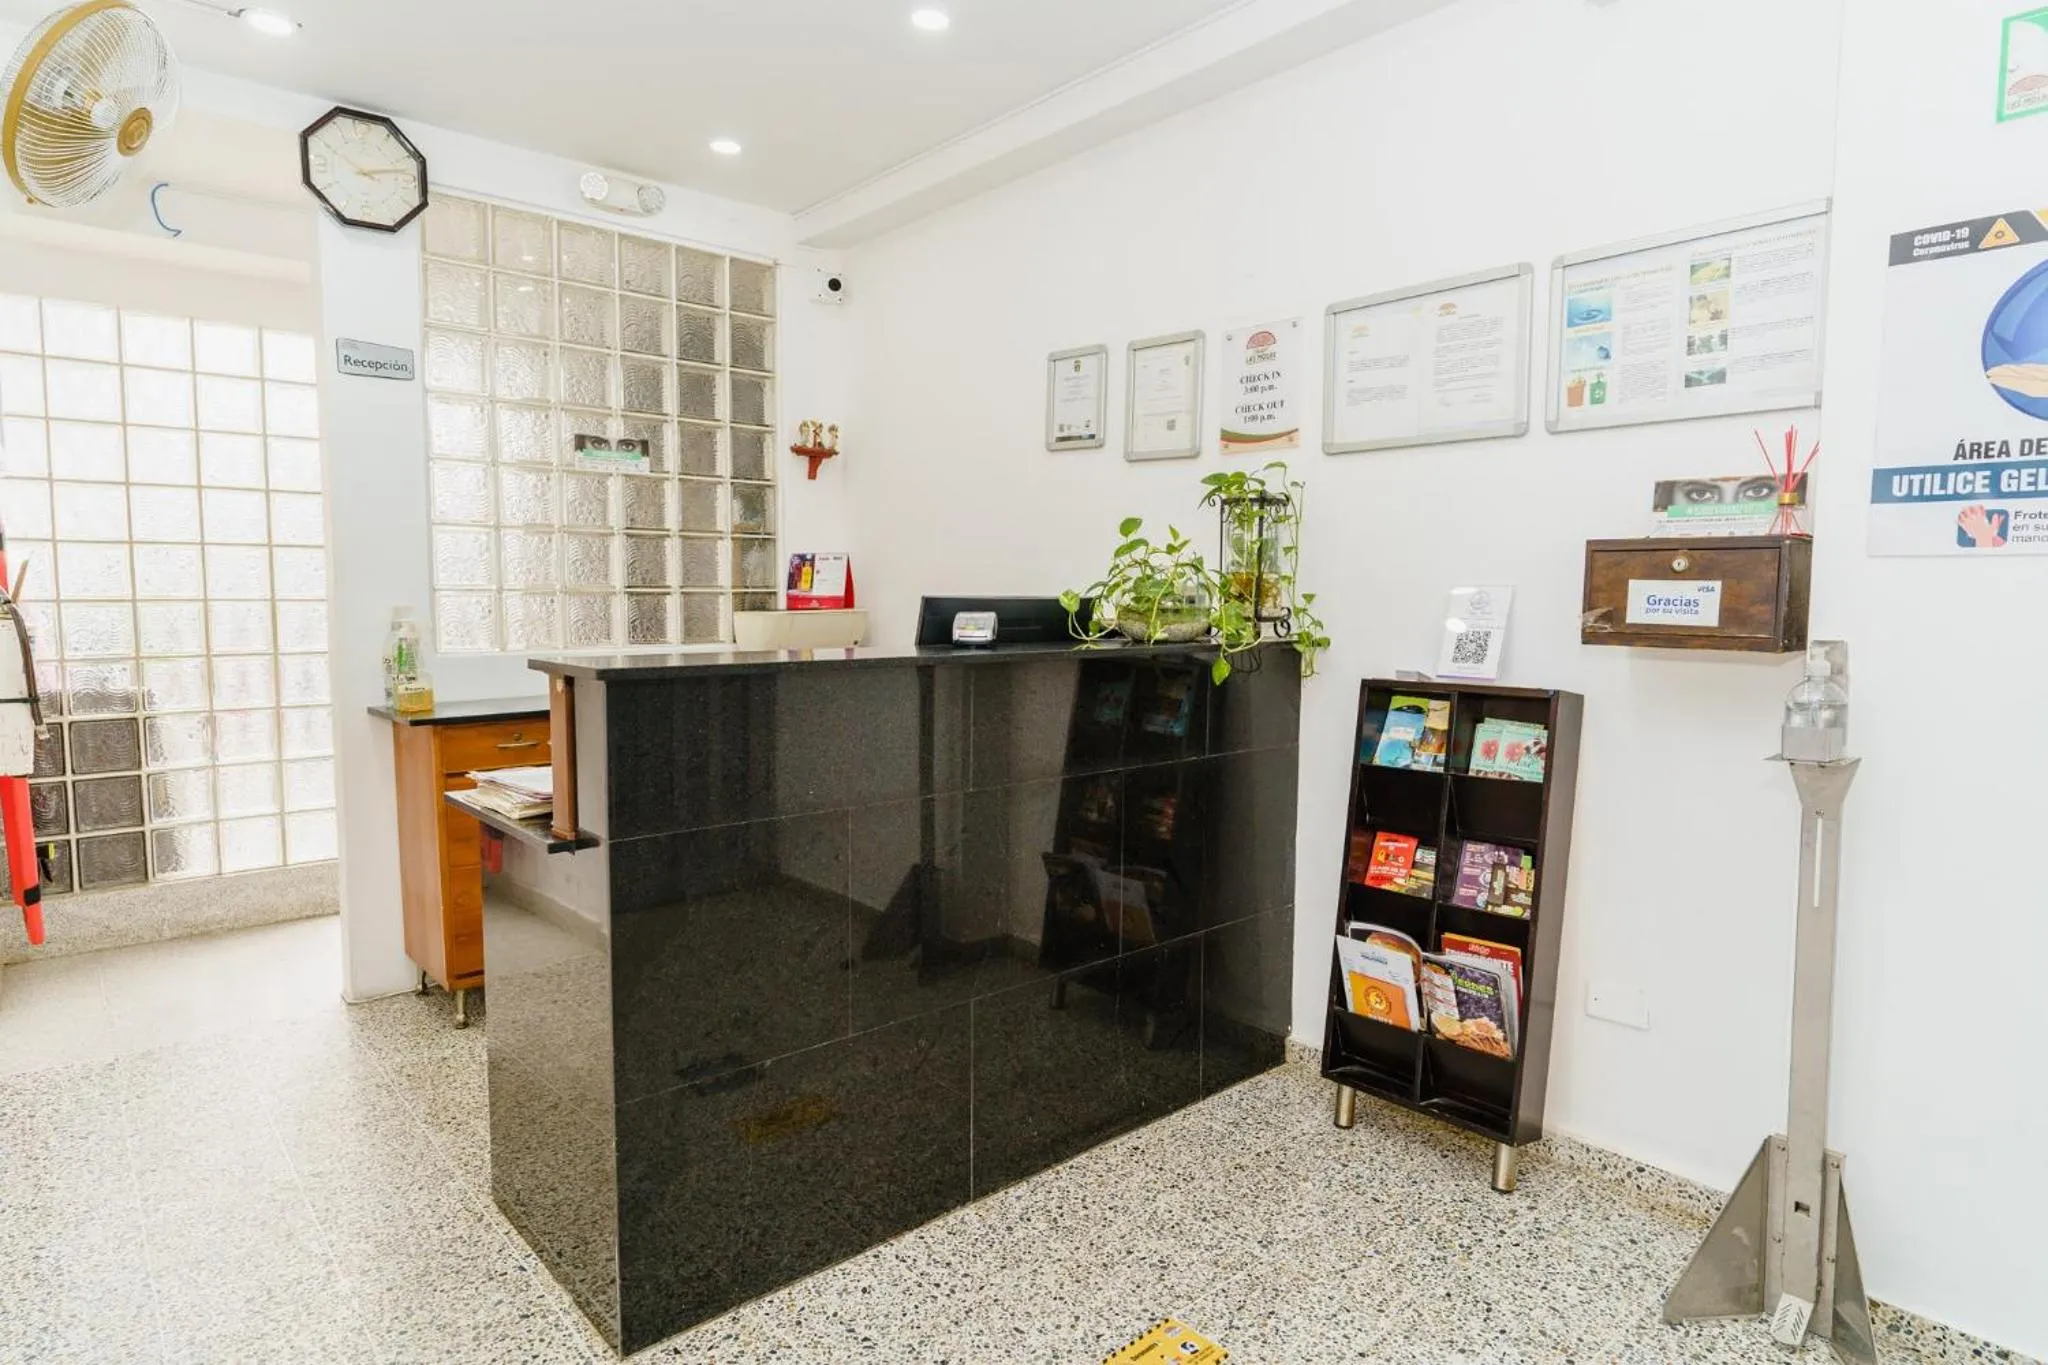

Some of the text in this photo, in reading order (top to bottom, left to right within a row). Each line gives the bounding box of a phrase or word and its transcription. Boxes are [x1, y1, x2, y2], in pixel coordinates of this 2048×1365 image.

[1913, 227, 1970, 247] COVID-19
[343, 354, 408, 372] Recepción
[1239, 370, 1281, 384] CHECK IN
[1235, 400, 1285, 414] CHECK OUT
[1953, 437, 2048, 461] ÁREA DE
[1892, 467, 2048, 497] UTILICE GEL
[1646, 594, 1700, 607] Gracias
[1645, 607, 1660, 615] por
[1674, 607, 1700, 615] visita
